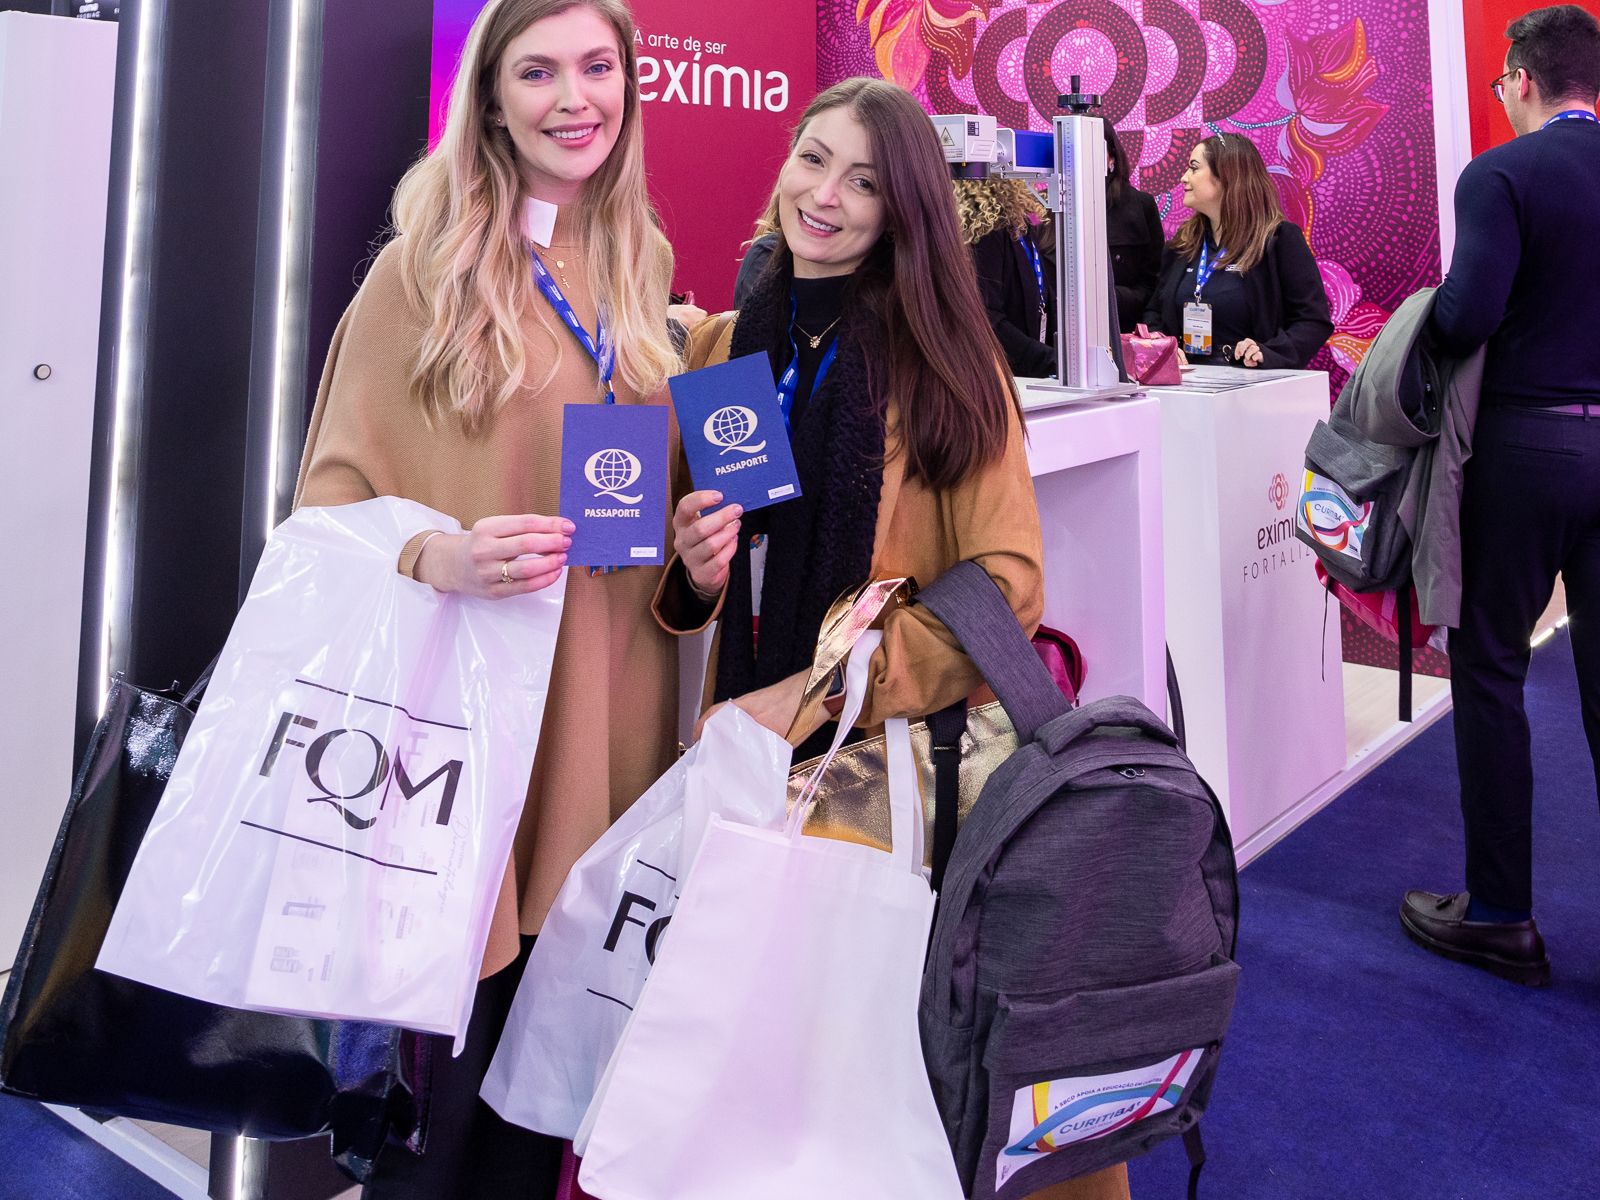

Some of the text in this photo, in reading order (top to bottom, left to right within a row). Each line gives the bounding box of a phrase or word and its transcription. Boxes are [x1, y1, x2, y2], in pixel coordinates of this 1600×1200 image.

[633, 29, 727, 55] A arte de ser
[715, 454, 768, 476] PASSAPORTE
[584, 508, 640, 518] PASSAPORTE
[1257, 517, 1295, 550] exími
[259, 711, 463, 831] FQM
